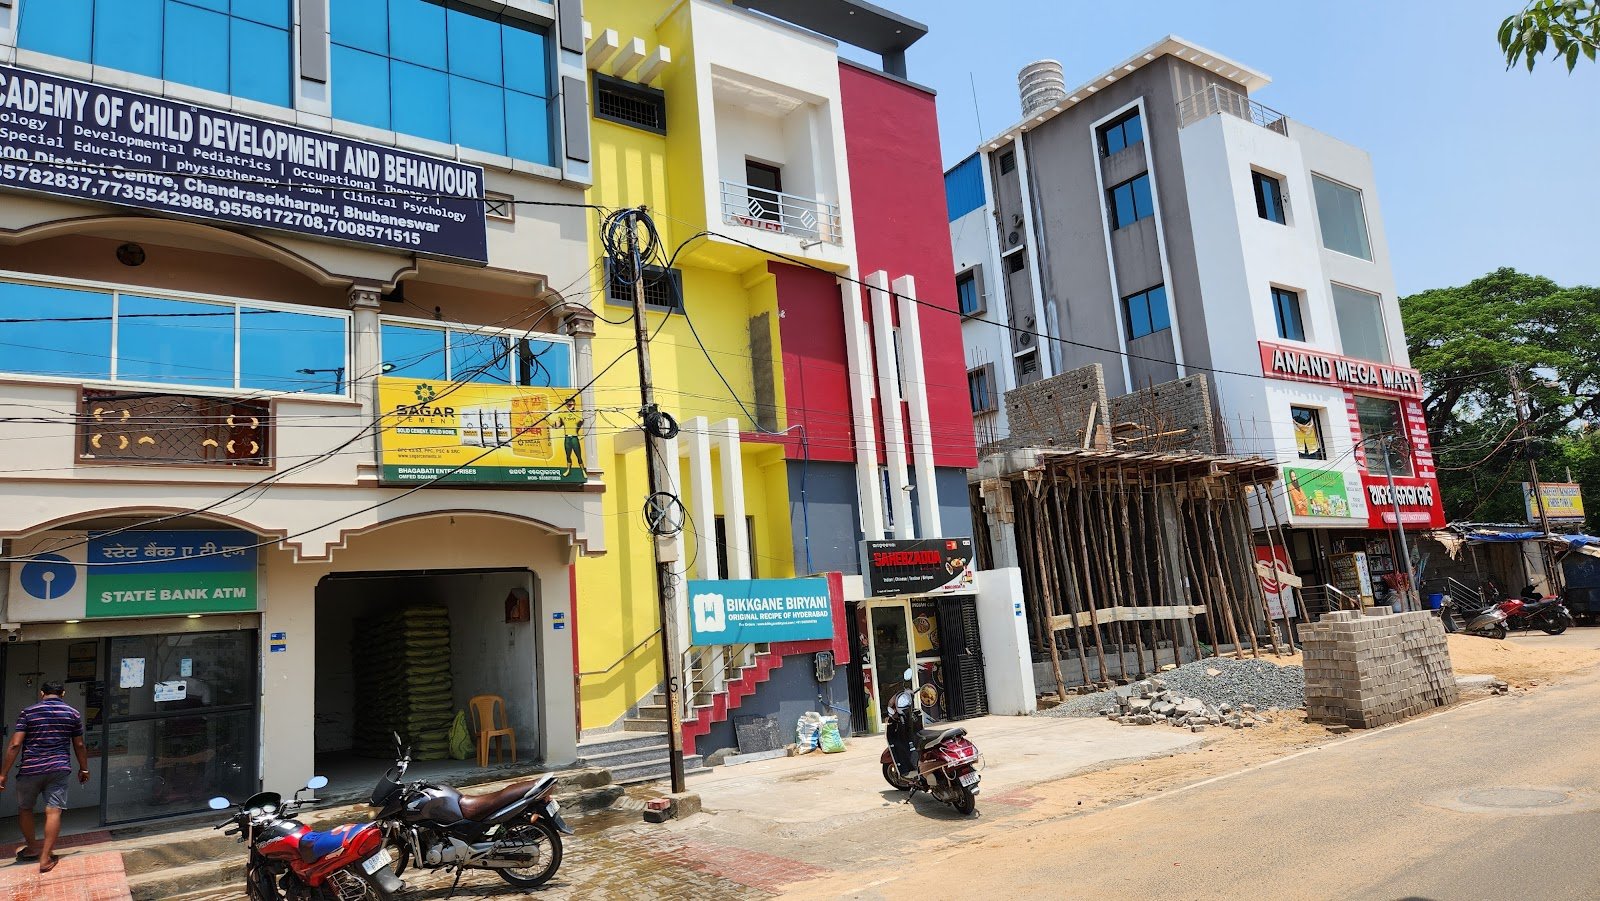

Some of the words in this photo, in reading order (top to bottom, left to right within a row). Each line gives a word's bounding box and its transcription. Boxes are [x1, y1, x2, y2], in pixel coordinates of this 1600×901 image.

[94, 94, 124, 128] OF
[129, 101, 194, 142] CHILD
[199, 114, 339, 171] DEVELOPMENT
[343, 146, 380, 179] AND
[384, 153, 478, 198] BEHAVIOUR
[74, 125, 185, 155] Developmental
[193, 147, 272, 171] Pediatrics
[293, 167, 377, 191] Occupational
[0, 127, 65, 149] Special
[74, 141, 152, 164] Education
[343, 190, 397, 209] Clinical
[403, 201, 467, 222] Psychology
[0, 144, 33, 167] 00,
[34, 150, 107, 177] District
[112, 164, 179, 191] Centre,
[184, 177, 340, 219] Chandrasekharpur,
[343, 205, 440, 233] Bhubaneswar
[1273, 349, 1331, 379] ANAND
[1335, 360, 1378, 385] MEGA
[1381, 368, 1419, 393] MART
[396, 404, 455, 418] SAGAR
[397, 416, 456, 424] CEMENT
[102, 543, 138, 559] स्टेट
[144, 542, 176, 558] बैंक
[101, 590, 156, 603] STATE
[160, 587, 208, 600] BANK
[212, 586, 247, 600] ATM
[726, 597, 784, 612] BIKKGANE
[785, 596, 828, 610] BIRYANI
[728, 612, 758, 621] ORIGINAL
[759, 612, 782, 620] RECIPE
[792, 610, 828, 619] HYDERABAD
